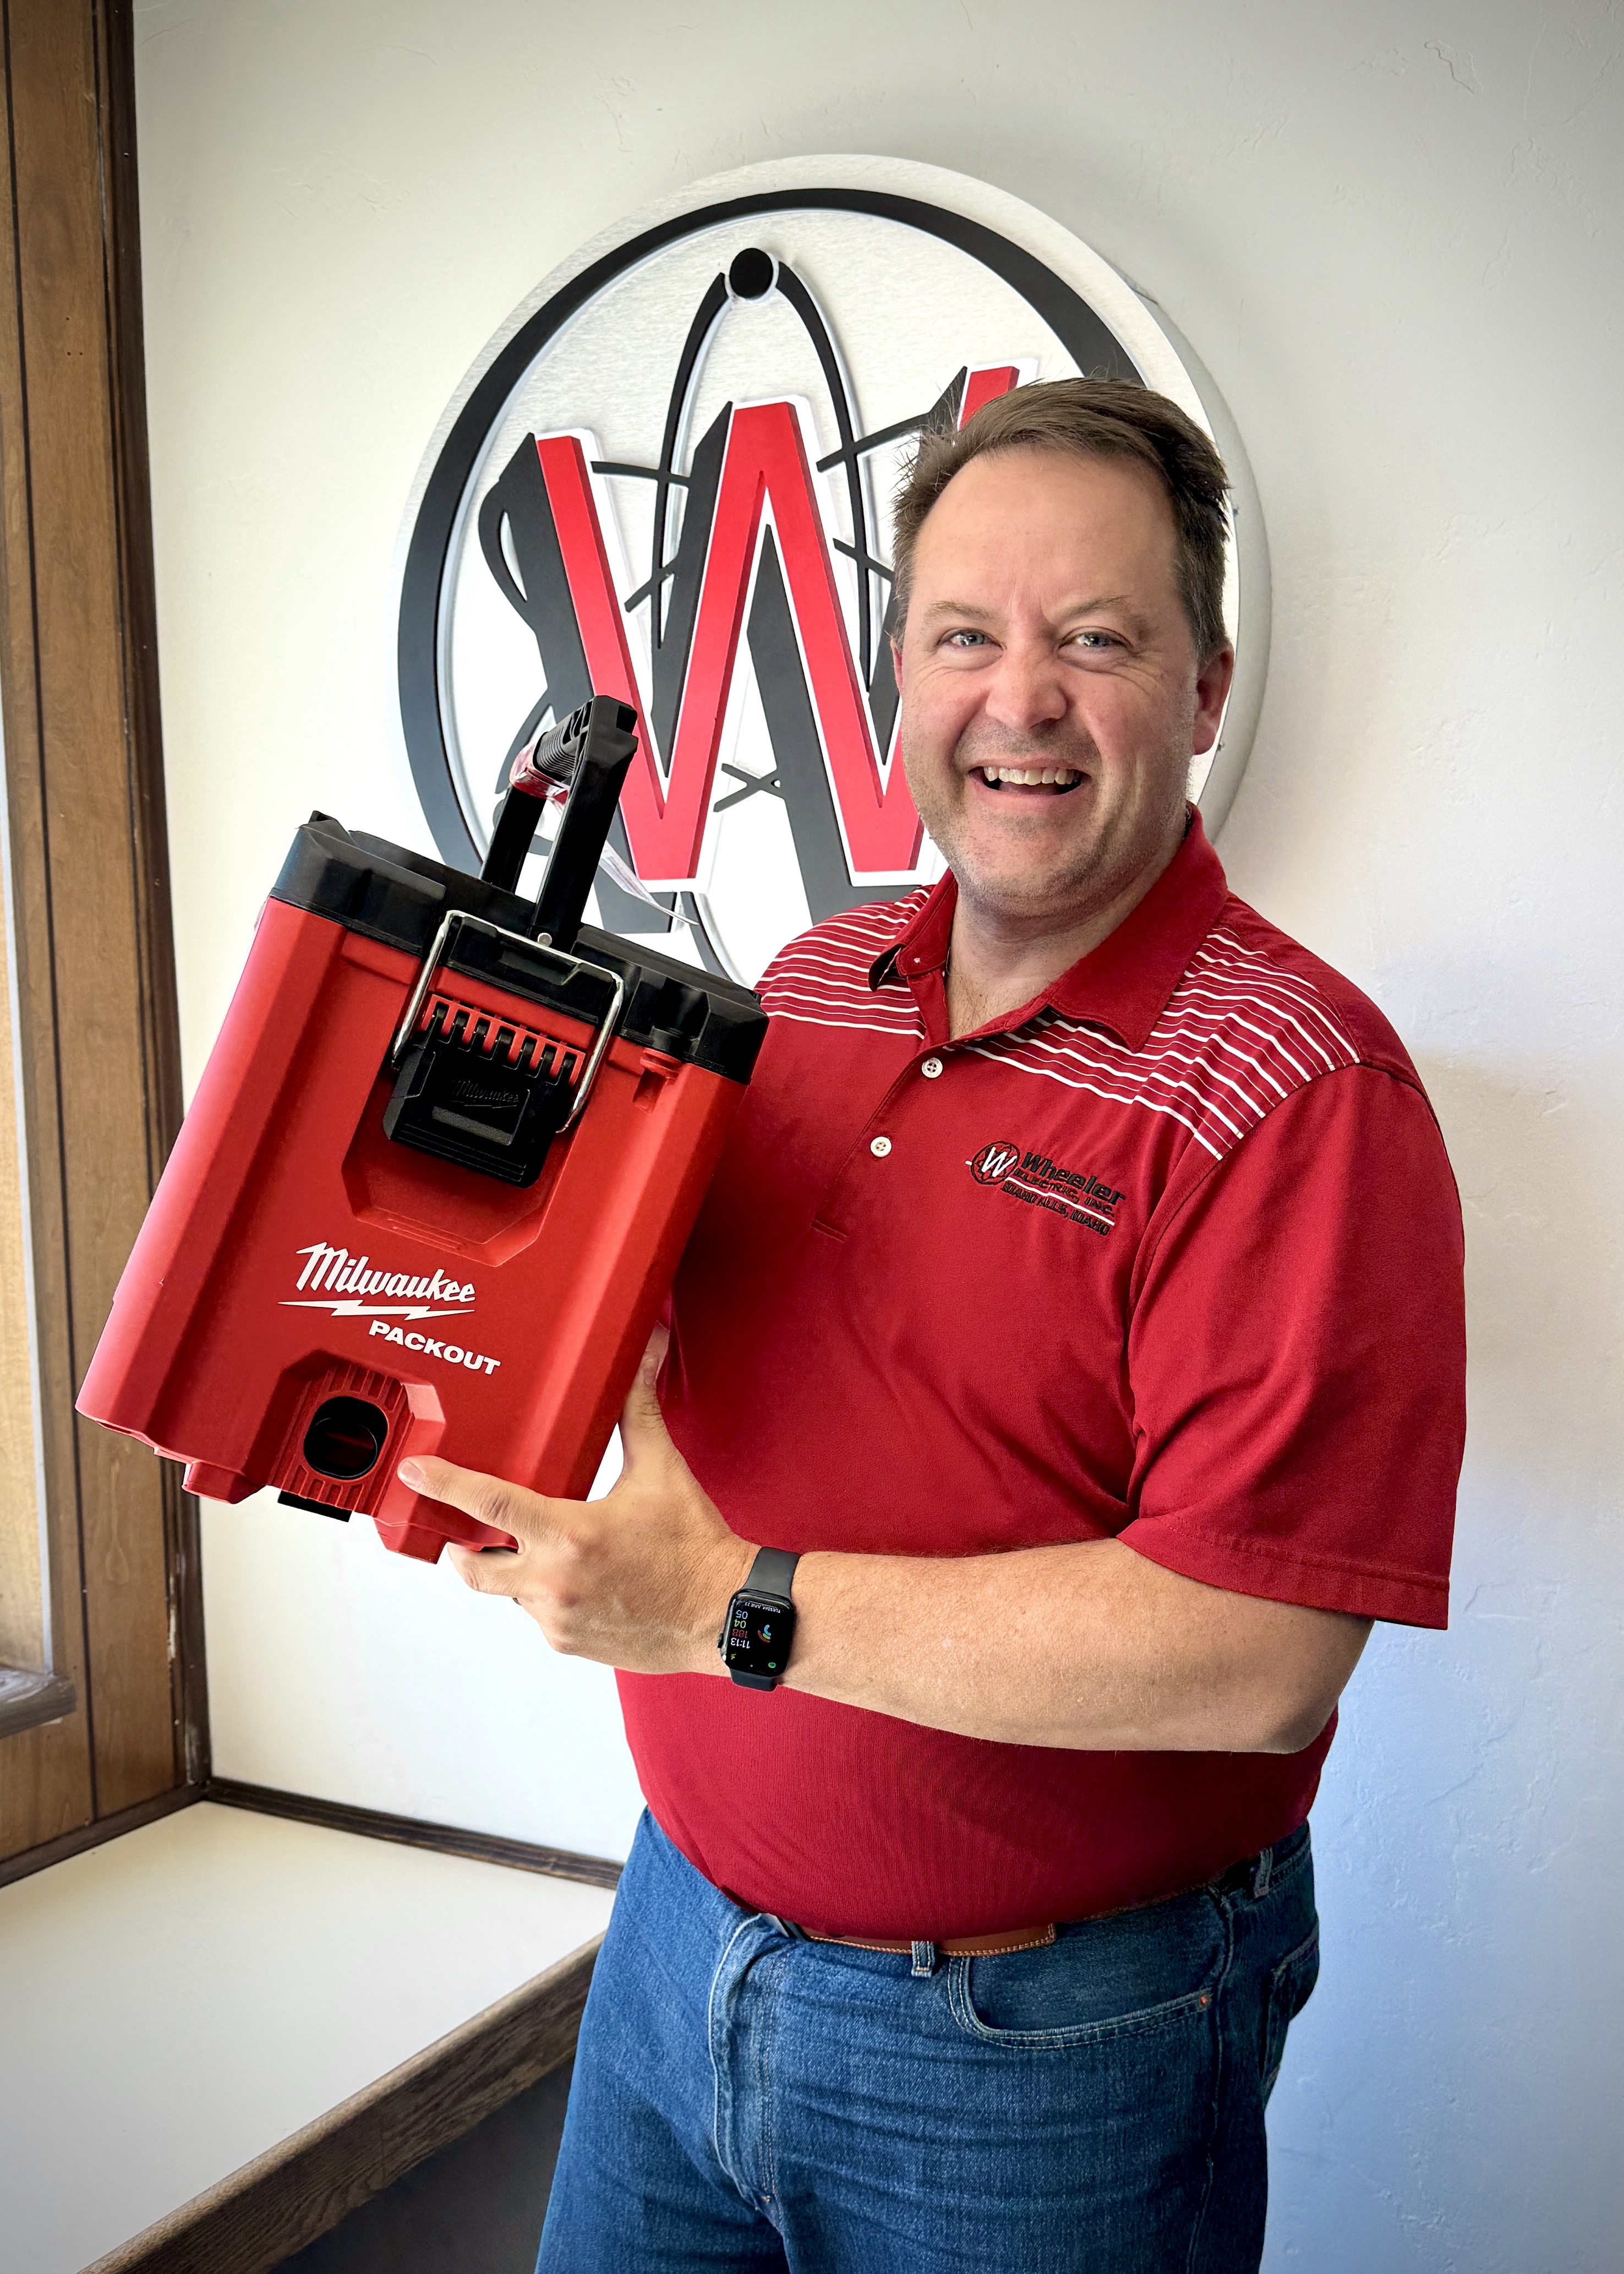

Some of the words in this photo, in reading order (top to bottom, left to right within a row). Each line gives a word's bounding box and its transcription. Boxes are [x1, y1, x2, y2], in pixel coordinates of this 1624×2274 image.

[538, 366, 1021, 881] W
[1020, 1151, 1126, 1206] Wheeler
[296, 1241, 476, 1302] Milwaukee
[368, 1319, 501, 1375] PACKOUT
[734, 1619, 746, 1628] 04
[736, 1610, 748, 1619] 05
[731, 1638, 751, 1649] 11:13
[732, 1629, 748, 1638] 188
